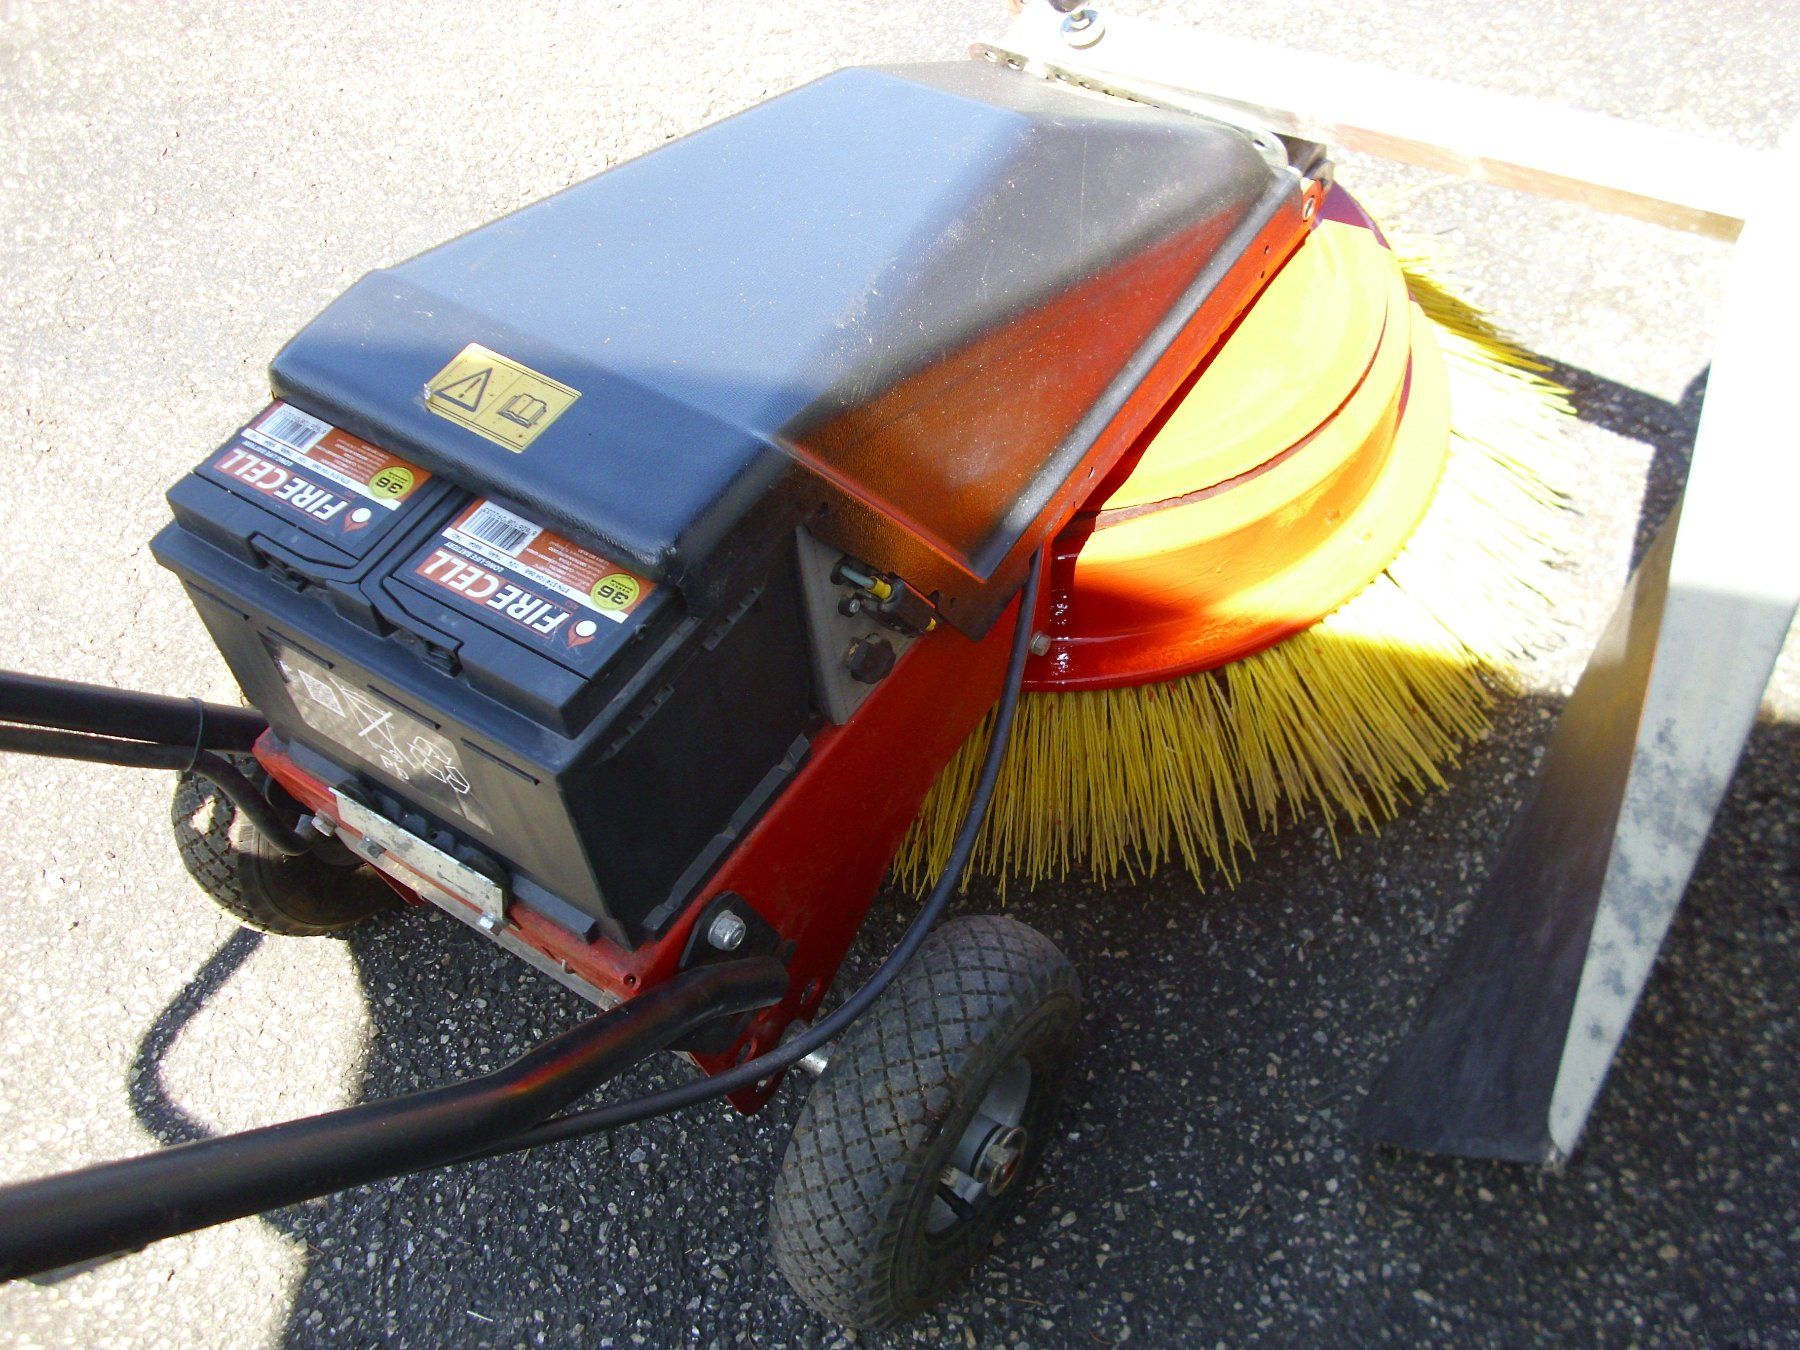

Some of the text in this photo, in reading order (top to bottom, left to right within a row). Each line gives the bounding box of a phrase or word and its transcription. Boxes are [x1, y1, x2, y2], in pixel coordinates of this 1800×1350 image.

[275, 456, 293, 466] LONG
[220, 448, 347, 519] FIRECELL
[443, 541, 504, 572] LONG LIFE BATTERY
[423, 549, 569, 633] FIRECELL
[597, 584, 628, 604] 36
